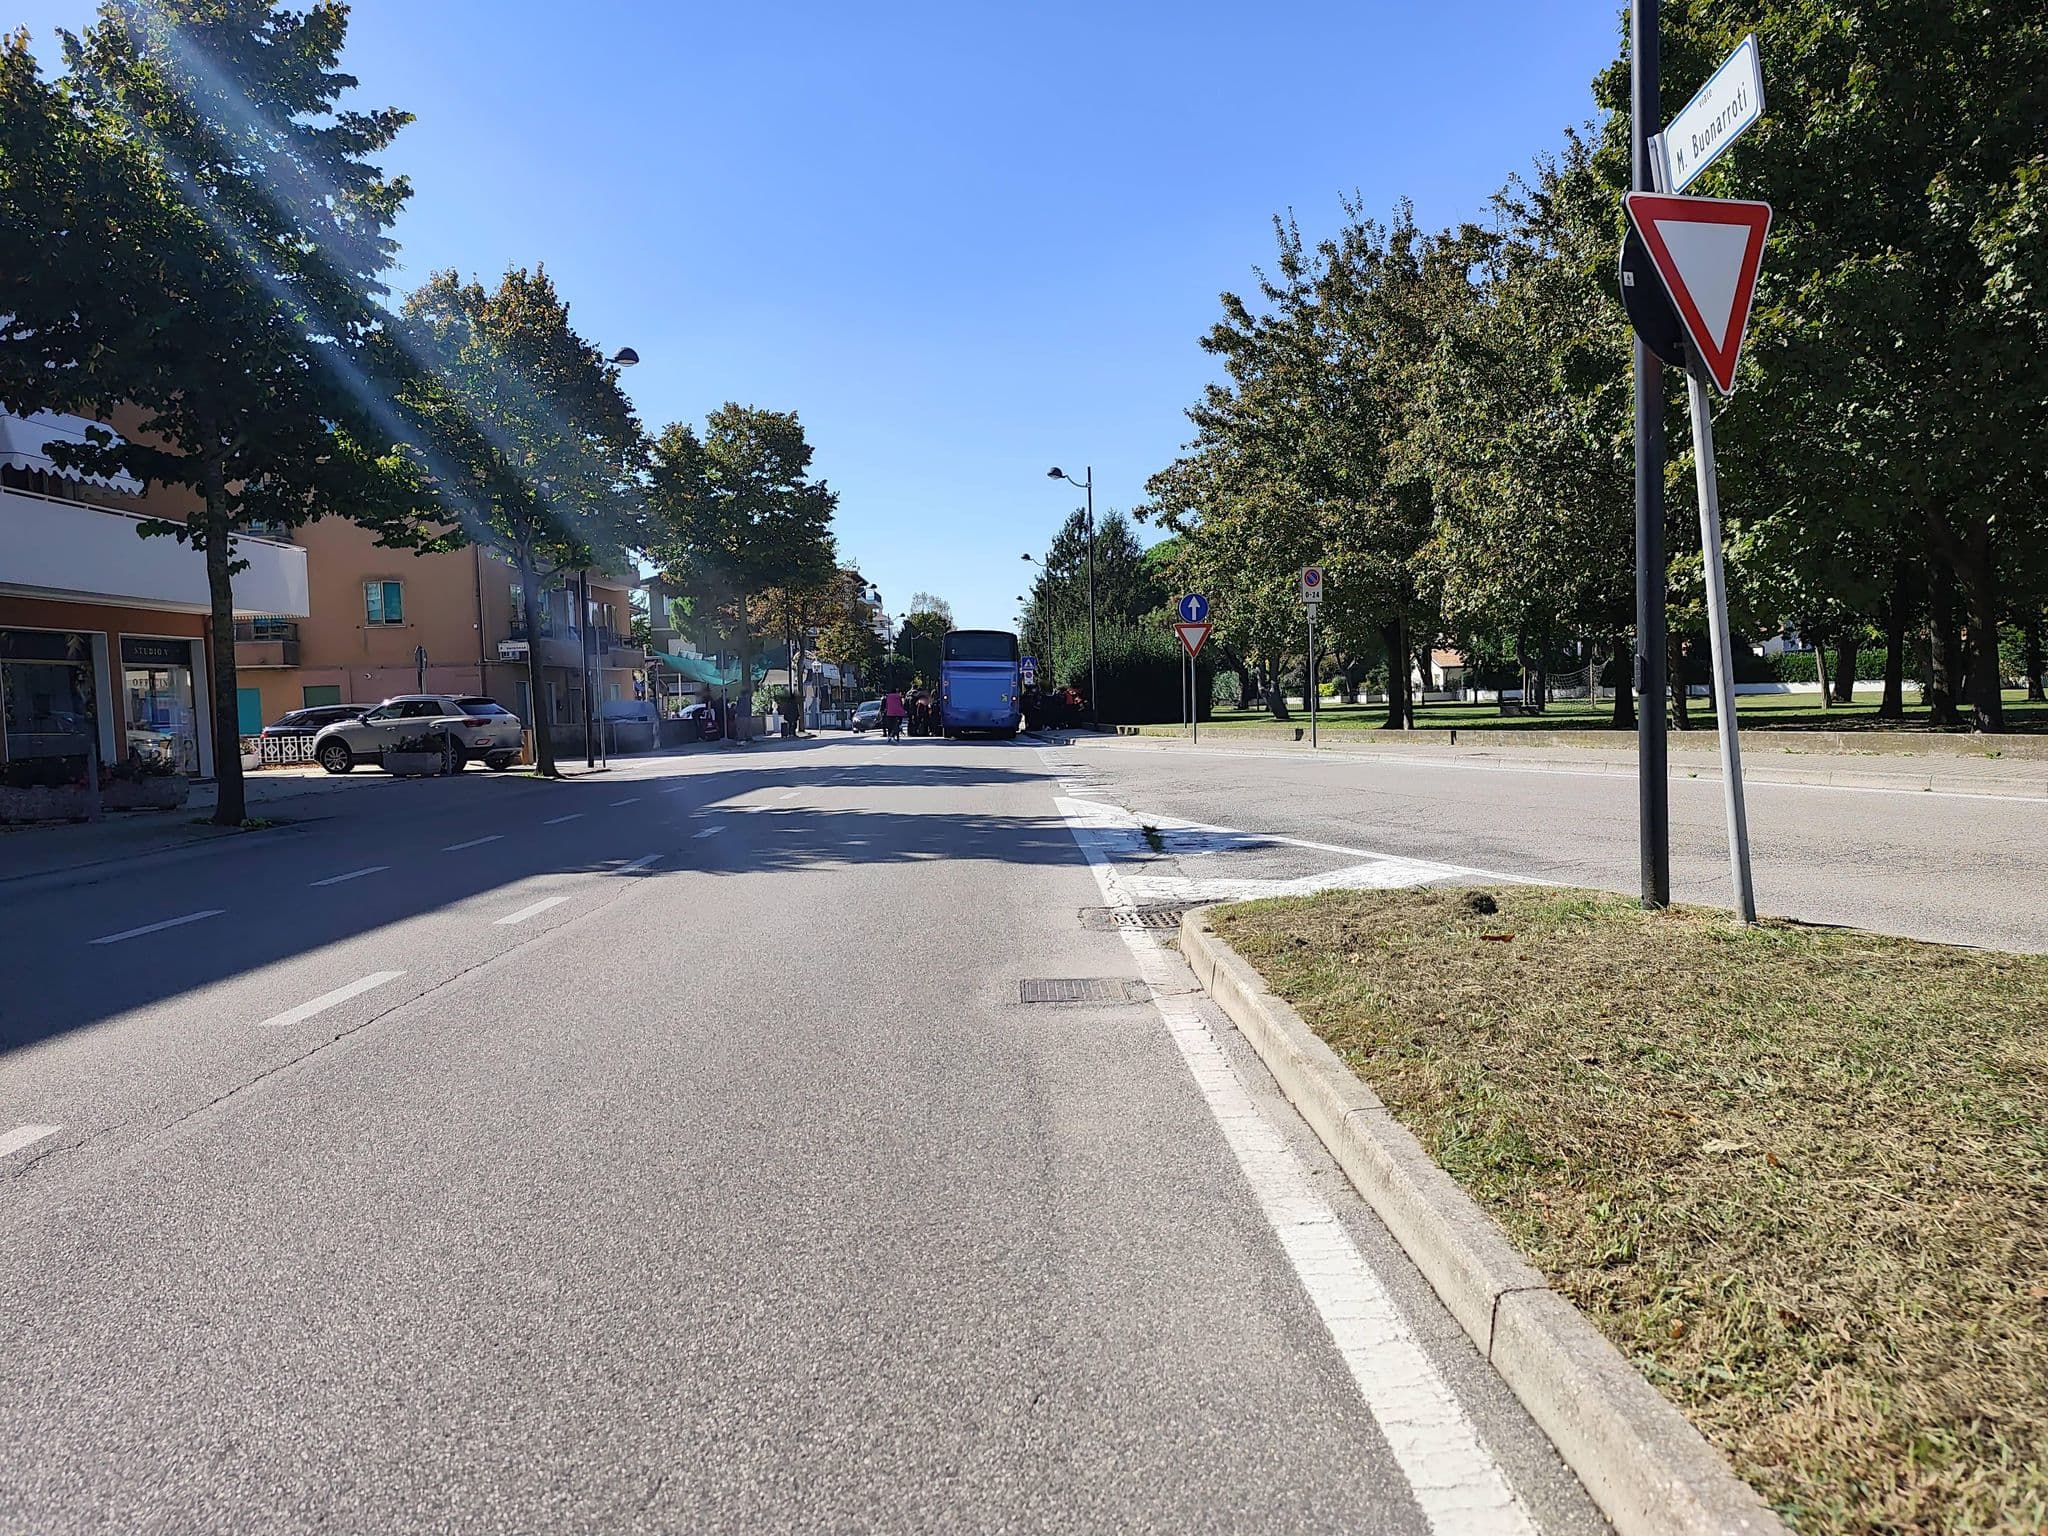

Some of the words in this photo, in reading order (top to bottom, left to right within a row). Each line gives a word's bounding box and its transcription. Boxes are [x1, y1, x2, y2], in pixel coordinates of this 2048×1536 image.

[1698, 88, 1713, 108] viale
[1676, 148, 1688, 174] M.
[1692, 82, 1748, 158] Buonarroti
[134, 647, 162, 656] STUDIO
